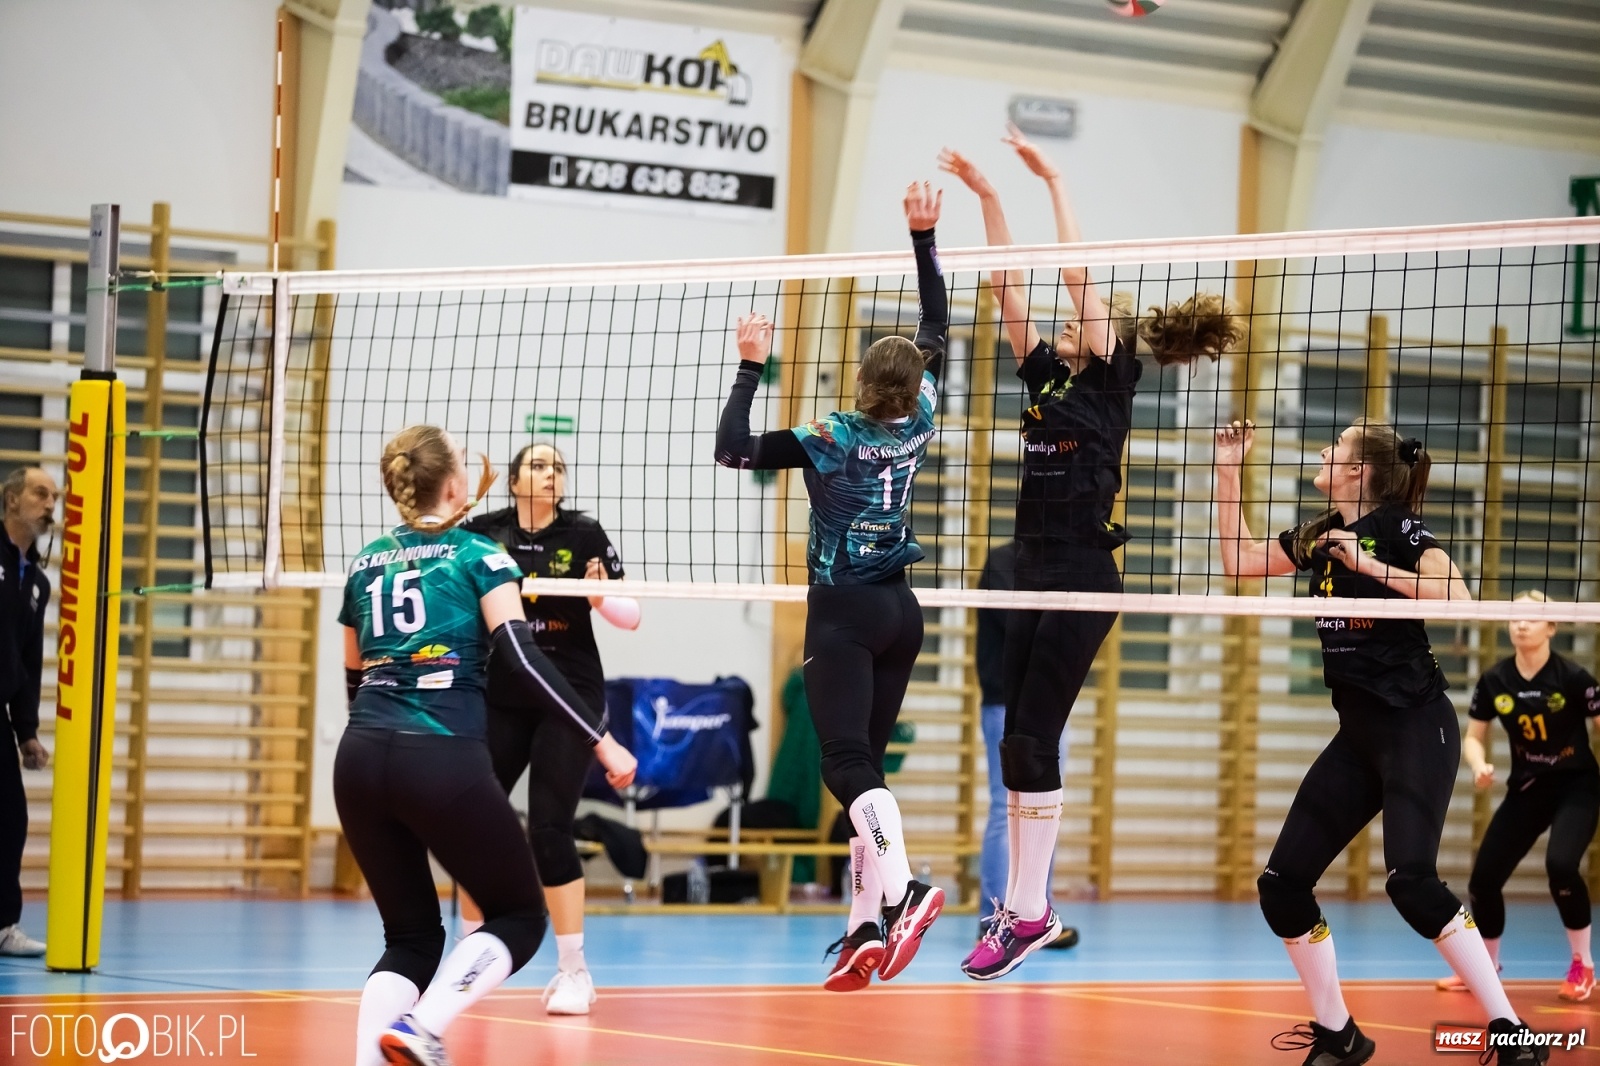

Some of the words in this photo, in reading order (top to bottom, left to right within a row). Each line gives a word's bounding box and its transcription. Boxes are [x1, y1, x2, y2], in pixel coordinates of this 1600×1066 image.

[525, 101, 768, 152] BRUKARSTWO
[575, 160, 628, 190] 798
[631, 165, 684, 196] 636
[858, 445, 880, 460] UKS
[878, 456, 918, 511] 17
[369, 544, 458, 568] KRZANOWICE
[366, 569, 426, 638] 15
[1349, 618, 1375, 631] JSW
[1518, 714, 1547, 741] 31
